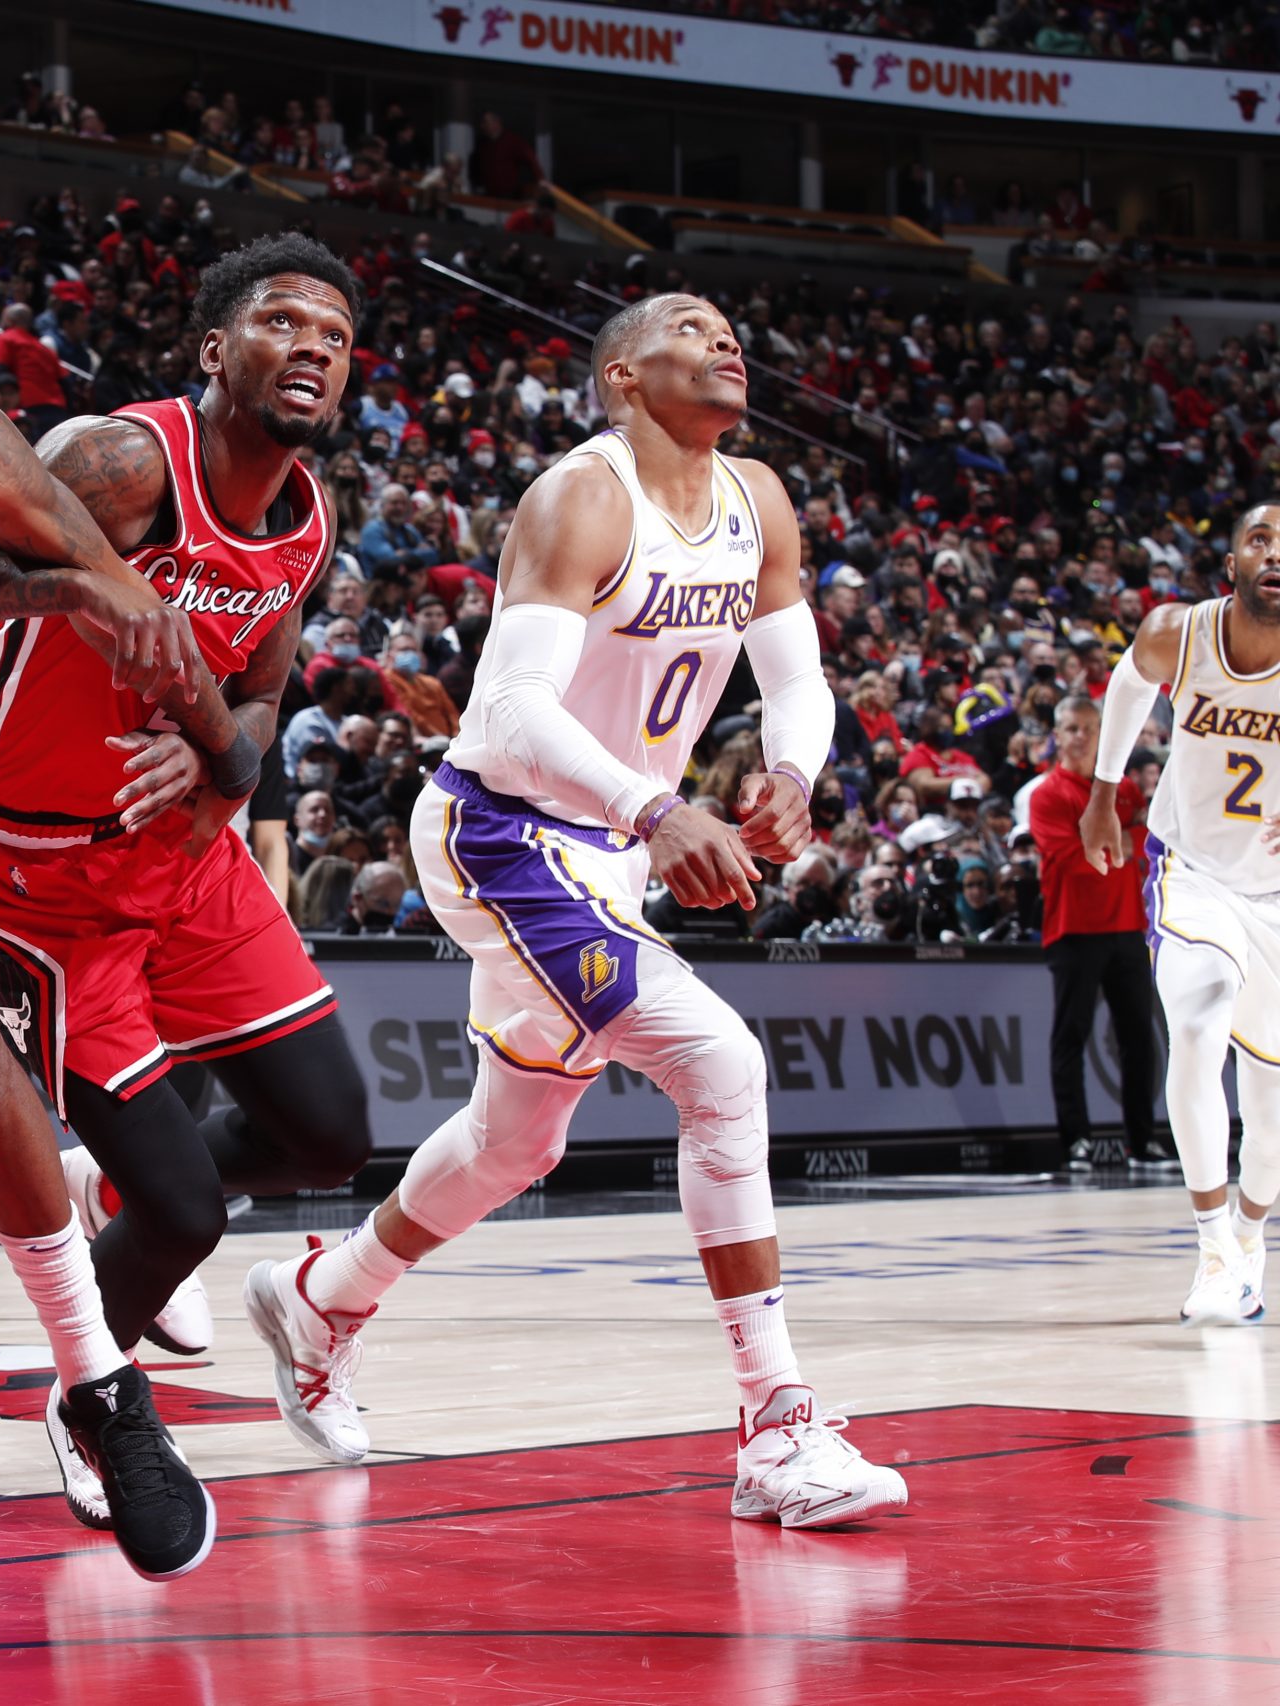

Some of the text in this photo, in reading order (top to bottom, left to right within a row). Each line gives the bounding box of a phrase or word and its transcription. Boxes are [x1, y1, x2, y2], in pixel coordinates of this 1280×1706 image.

[520, 12, 684, 65] DUNKIN'
[907, 58, 1072, 108] DUNKIN'
[143, 554, 295, 649] Chicago
[609, 570, 757, 642] LAKERS
[640, 649, 704, 747] 0
[1179, 691, 1280, 744] LAKER
[1222, 750, 1265, 823] 2
[368, 1018, 478, 1101] SE
[864, 1014, 1025, 1090] NOW
